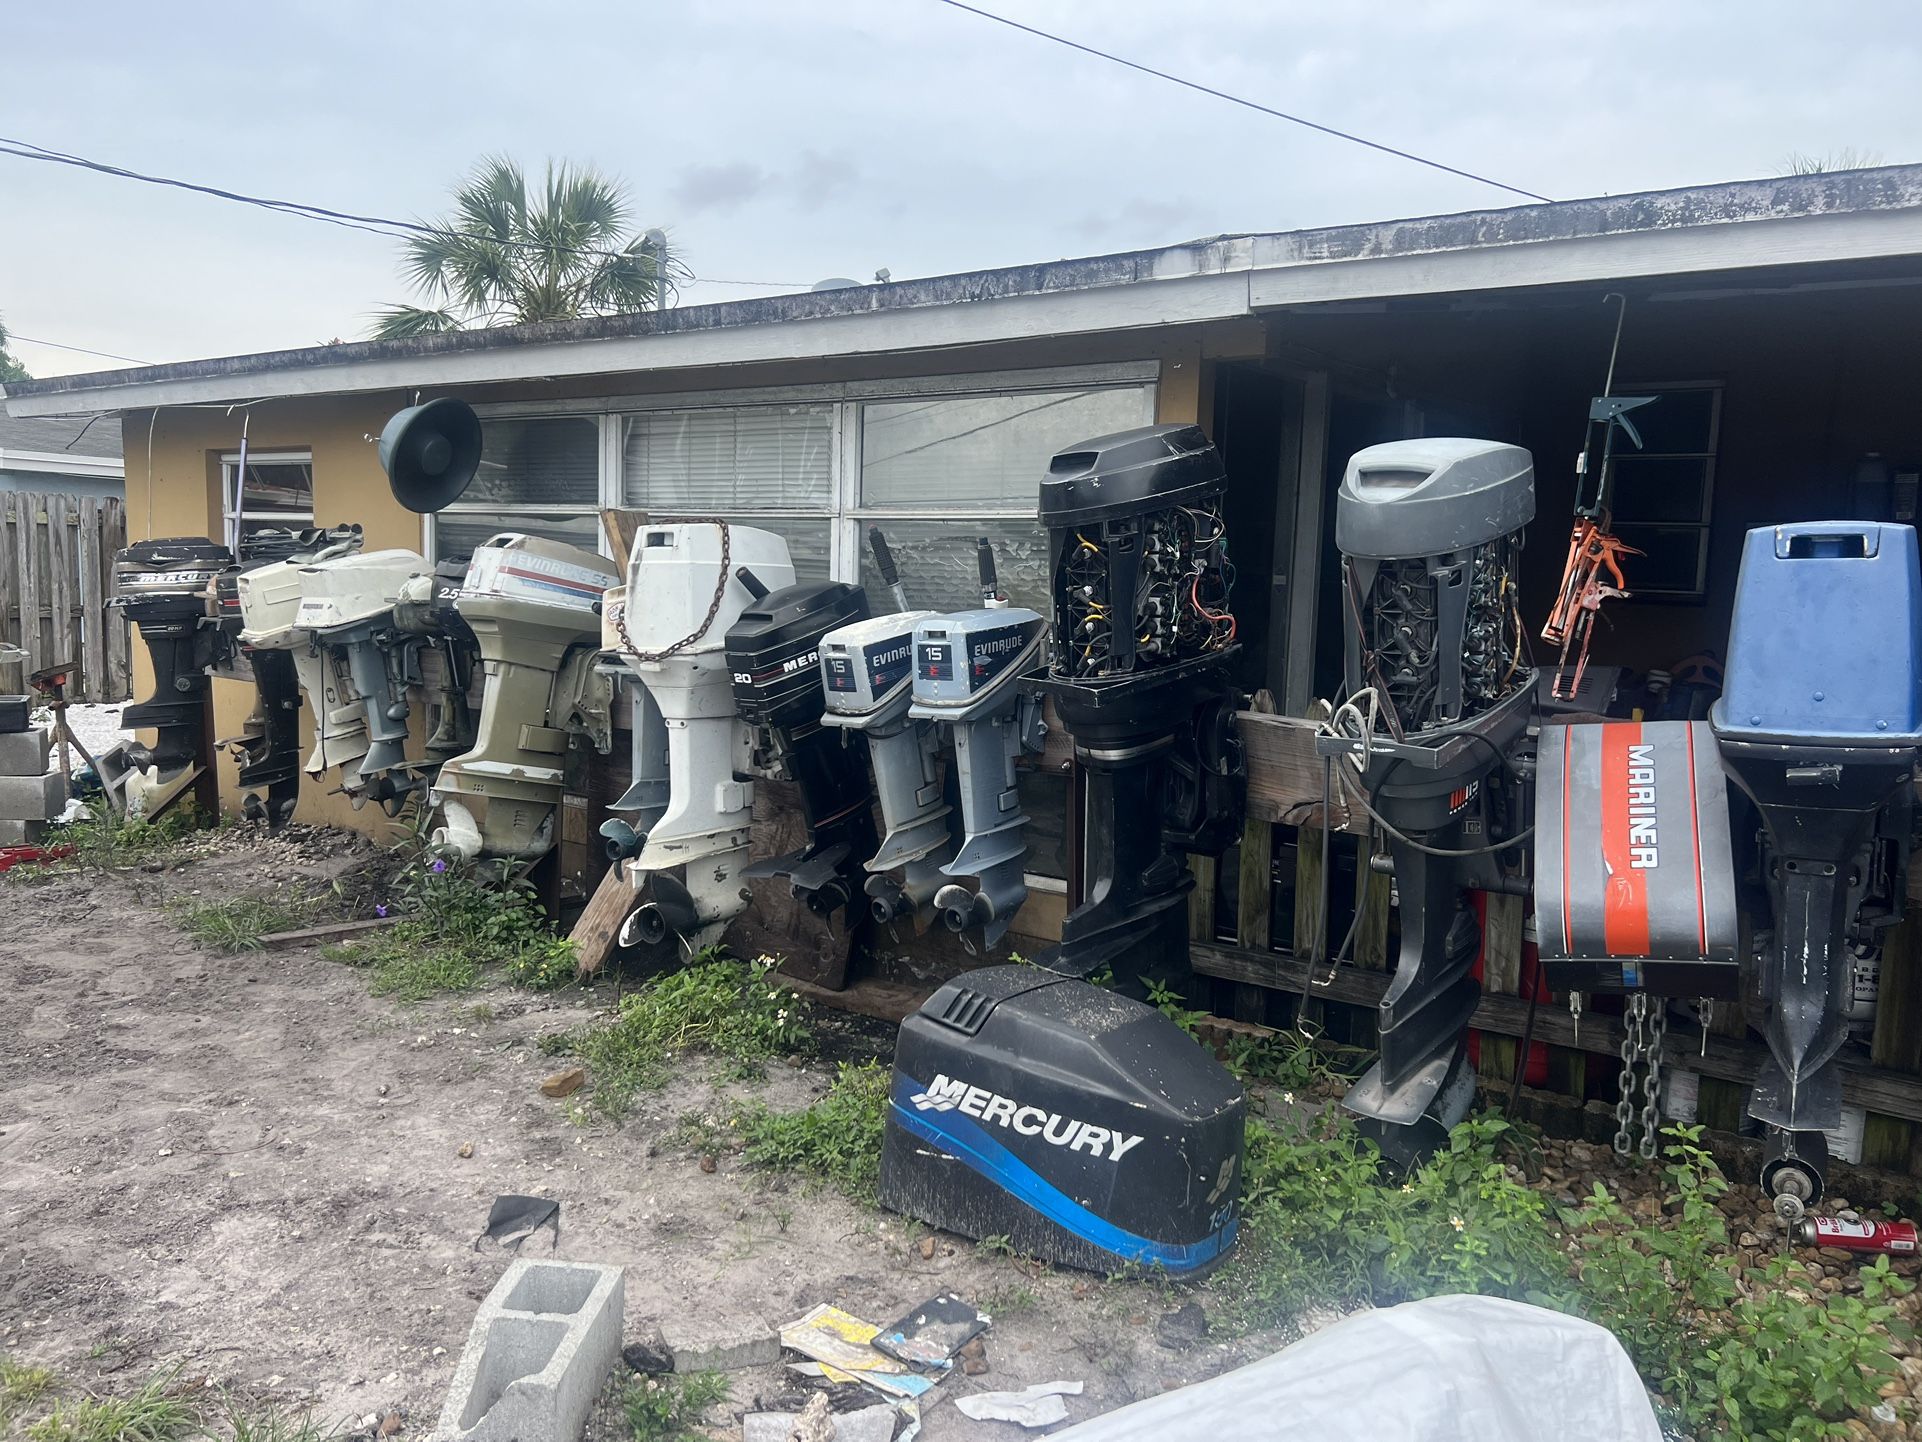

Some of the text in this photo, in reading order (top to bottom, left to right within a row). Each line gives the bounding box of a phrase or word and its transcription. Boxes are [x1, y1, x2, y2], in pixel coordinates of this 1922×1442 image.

[139, 572, 213, 583] MERCUR
[438, 587, 460, 599] 25
[926, 647, 942, 660] 15
[974, 635, 1022, 656] EVINRUDE
[783, 651, 820, 673] MER
[873, 643, 912, 667] EVINRU
[831, 660, 845, 673] 15
[734, 673, 751, 684] 20
[1628, 744, 1659, 869] MARINER
[910, 1073, 1144, 1162] MERCURY
